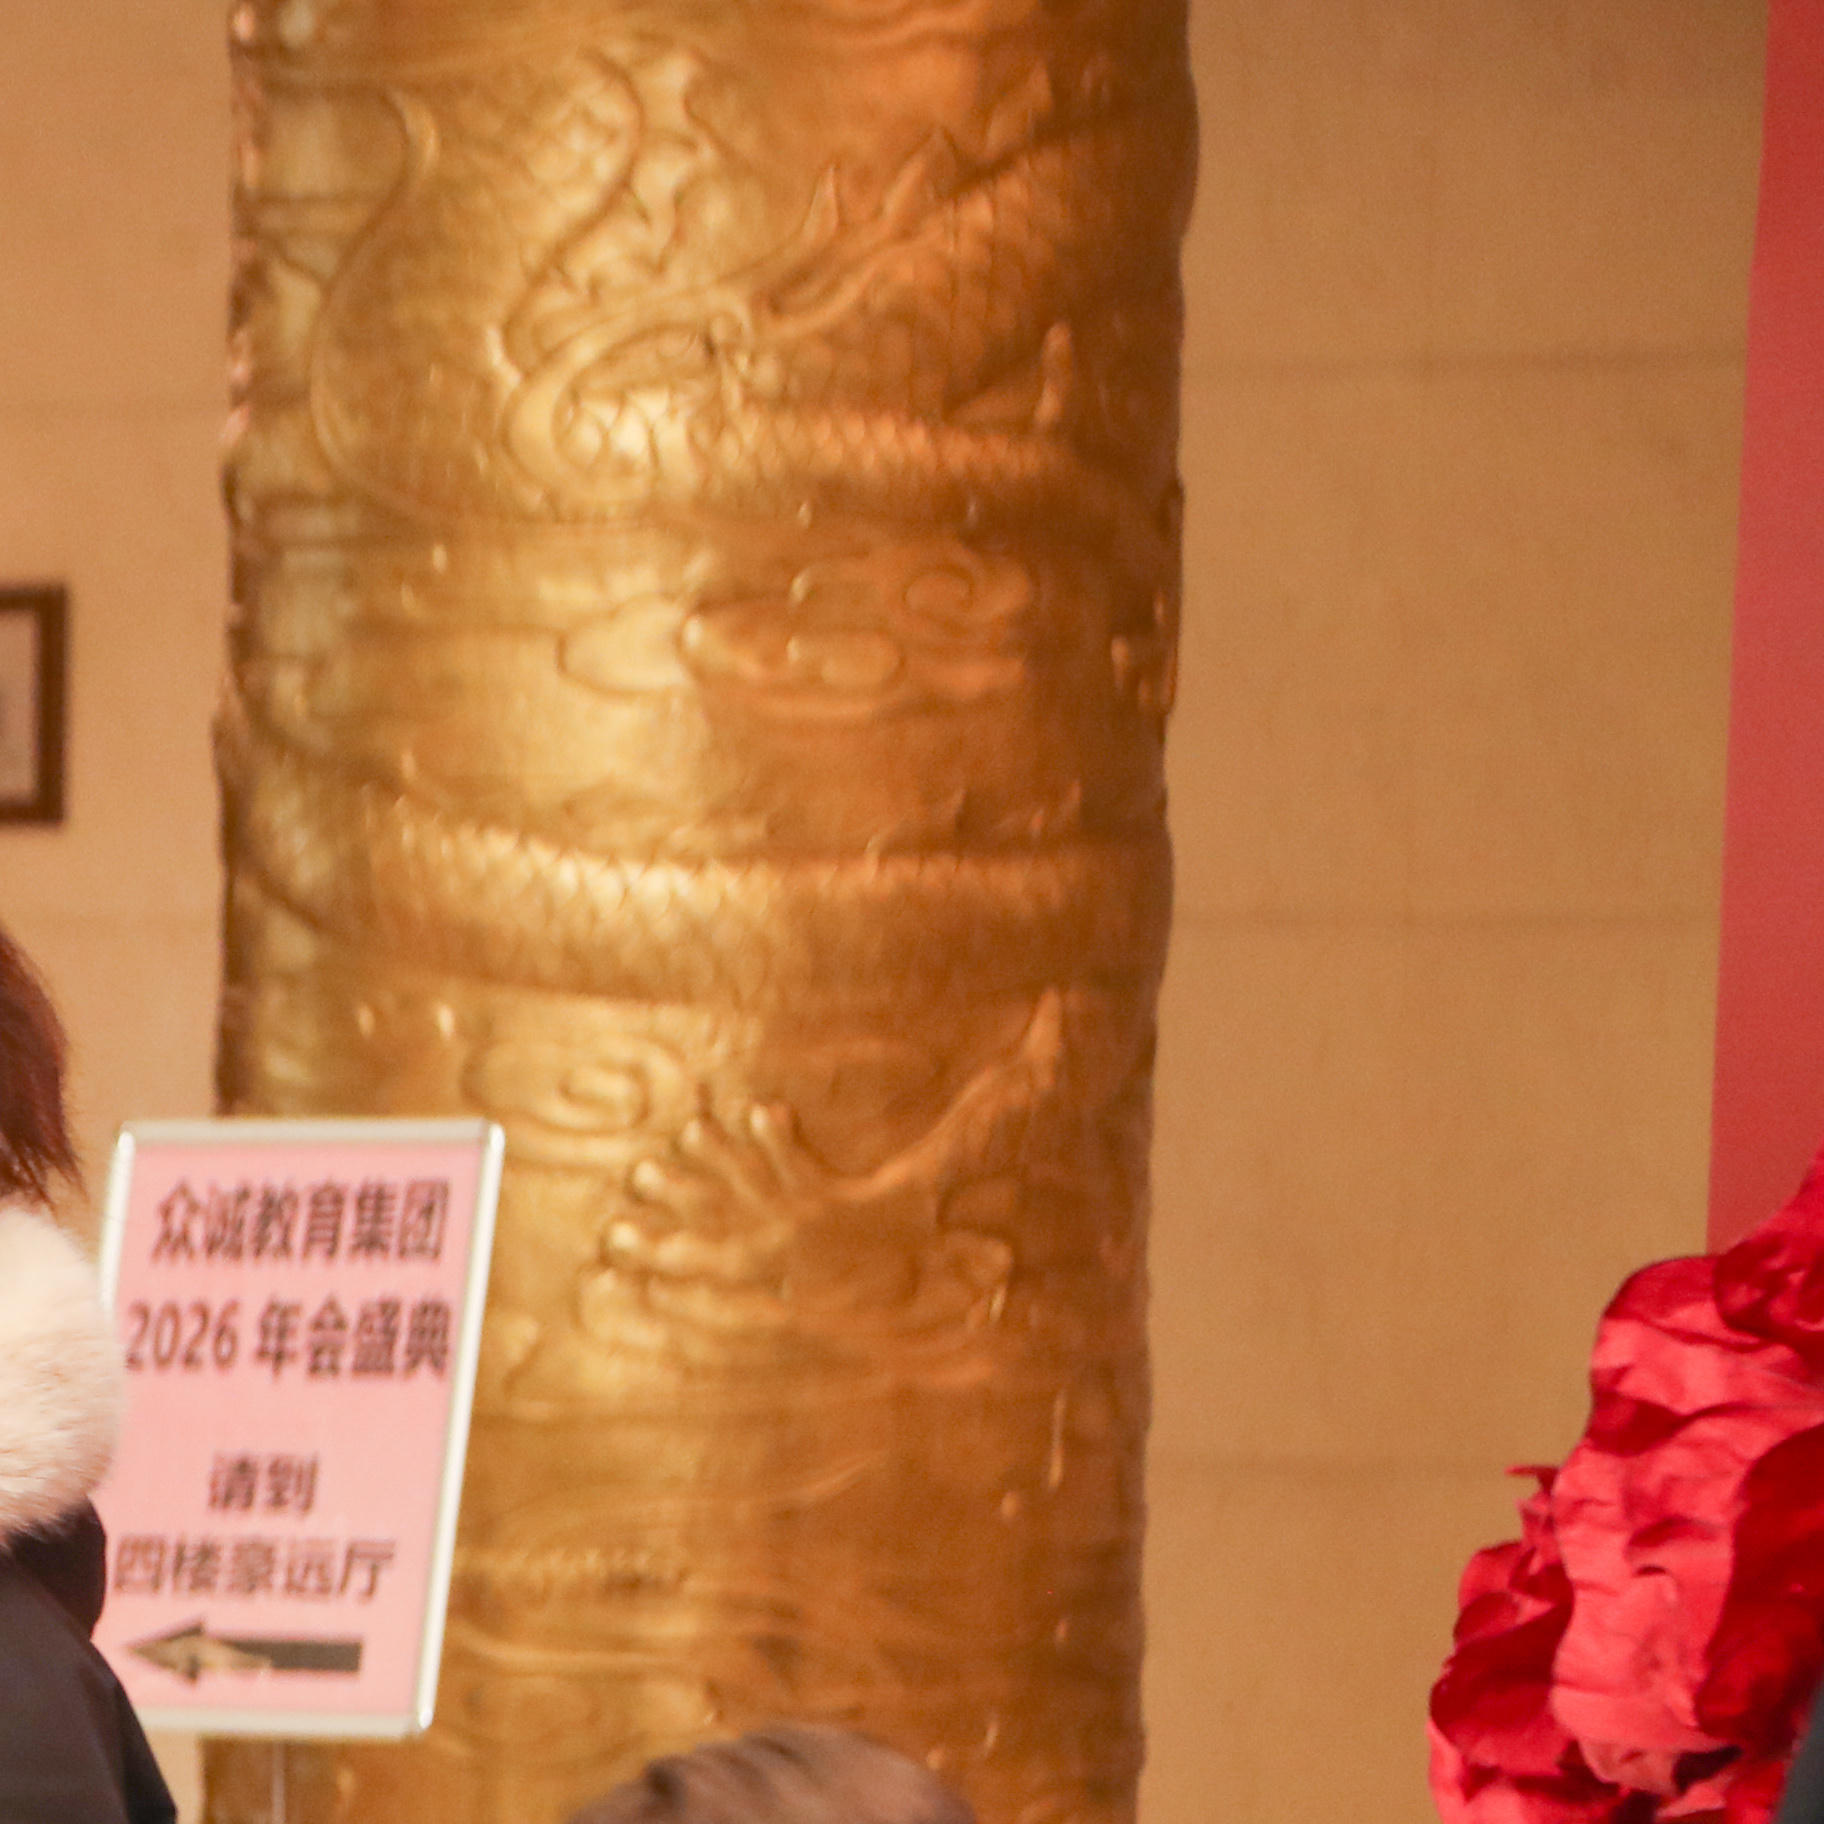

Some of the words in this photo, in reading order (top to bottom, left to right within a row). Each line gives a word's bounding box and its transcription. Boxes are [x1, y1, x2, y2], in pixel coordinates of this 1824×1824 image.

[151, 1178, 450, 1264] 众诚教育集团
[126, 1299, 240, 1373] 2026
[254, 1294, 450, 1383] 年会盛典
[207, 1450, 319, 1517] 请到
